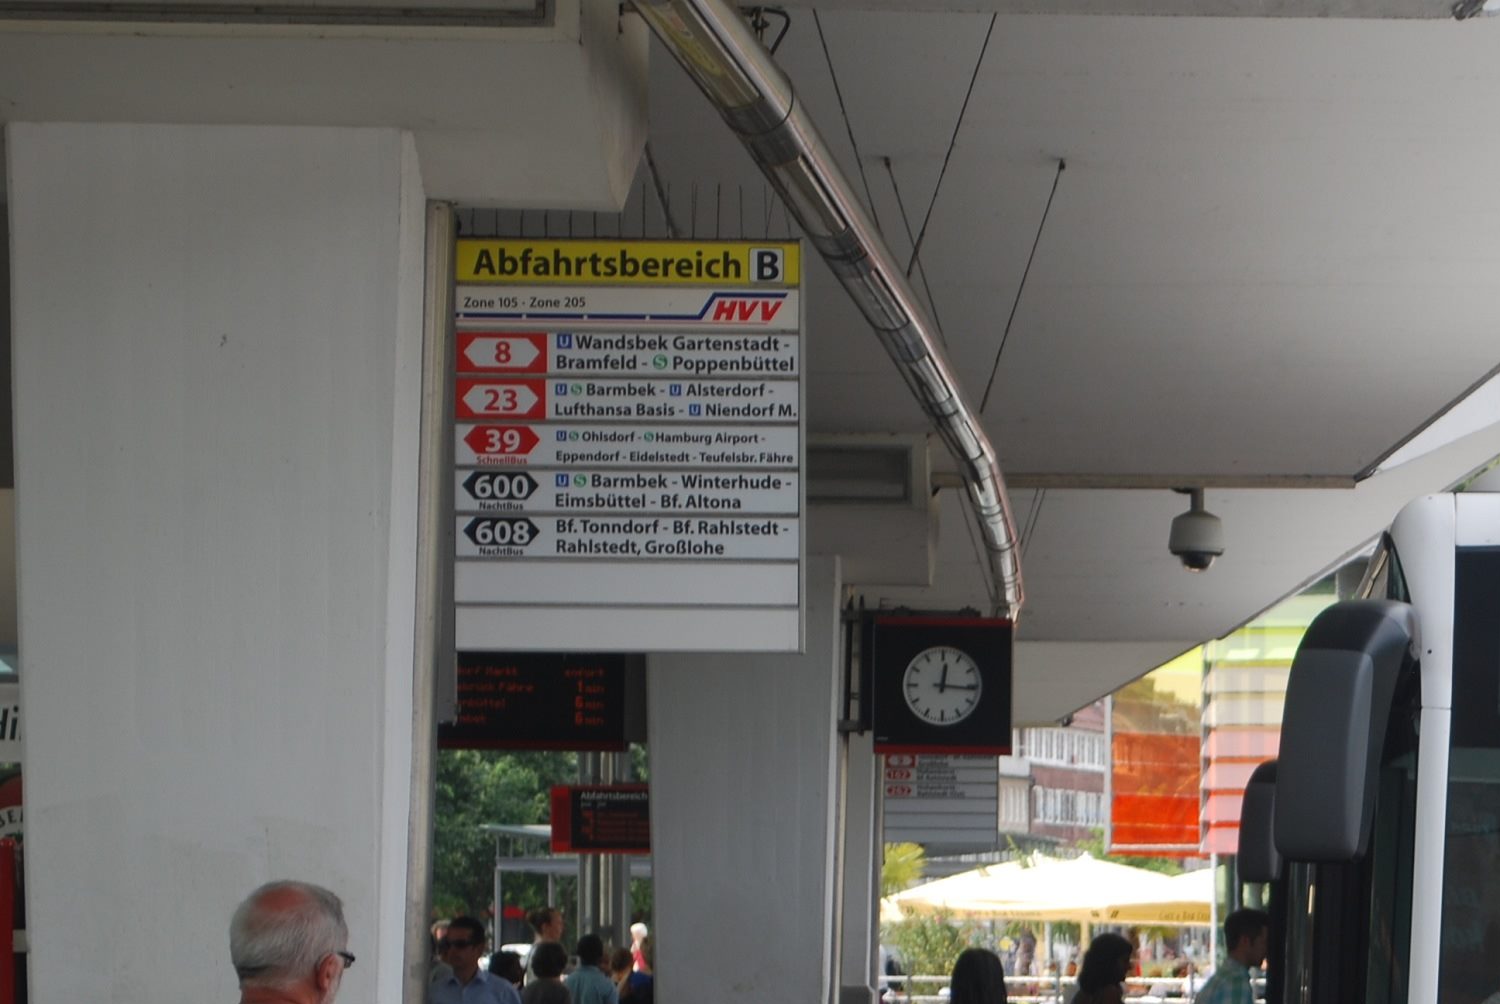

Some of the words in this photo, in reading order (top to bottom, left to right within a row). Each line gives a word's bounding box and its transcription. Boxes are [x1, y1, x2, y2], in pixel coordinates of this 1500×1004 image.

[473, 248, 742, 277] Abfahrtsbereich
[756, 251, 779, 281] B
[464, 297, 495, 308] Zone
[499, 297, 518, 308] 105
[529, 297, 560, 308] Zone
[564, 297, 586, 308] 205
[712, 301, 782, 321] HVV
[576, 335, 668, 351] Wandsbek
[673, 335, 780, 352] Gartenstadt
[494, 341, 512, 364] 8
[556, 354, 638, 370] Bramfeld
[673, 355, 794, 374] Poppenbüttel
[586, 383, 656, 397] Barmbek
[686, 384, 766, 398] Alsterdorf
[484, 388, 517, 412] 23
[555, 403, 632, 417] Lufthansa
[636, 404, 675, 417] Basis
[705, 404, 775, 418] Niendorf
[778, 404, 798, 418] M.
[485, 428, 520, 453] 39
[582, 431, 635, 443] Ohlsdorf
[655, 432, 712, 445] Hamburg
[714, 432, 759, 445] Airport
[477, 456, 528, 465] SchnellBus
[556, 451, 621, 463] Eppendorf
[629, 452, 690, 463] Eidelstedt
[699, 452, 757, 464] Teufelsbr.
[759, 452, 794, 464] Fähre
[474, 475, 529, 499] 600
[591, 474, 668, 489] Barmbek
[681, 475, 782, 490] Winterhude
[479, 502, 524, 511] NachtBus
[555, 493, 646, 508] Eimsbüttel
[660, 494, 682, 508] Bf.
[685, 494, 742, 509] Altona
[475, 520, 530, 545] 608
[556, 520, 578, 534] Bf.
[580, 520, 659, 534] Tonndorf
[673, 521, 694, 535] Bf.
[698, 521, 780, 535] Rahlstedt
[479, 547, 524, 556] NachtBus
[556, 540, 641, 556] Rahlstedt,
[645, 540, 725, 556] Großlohe
